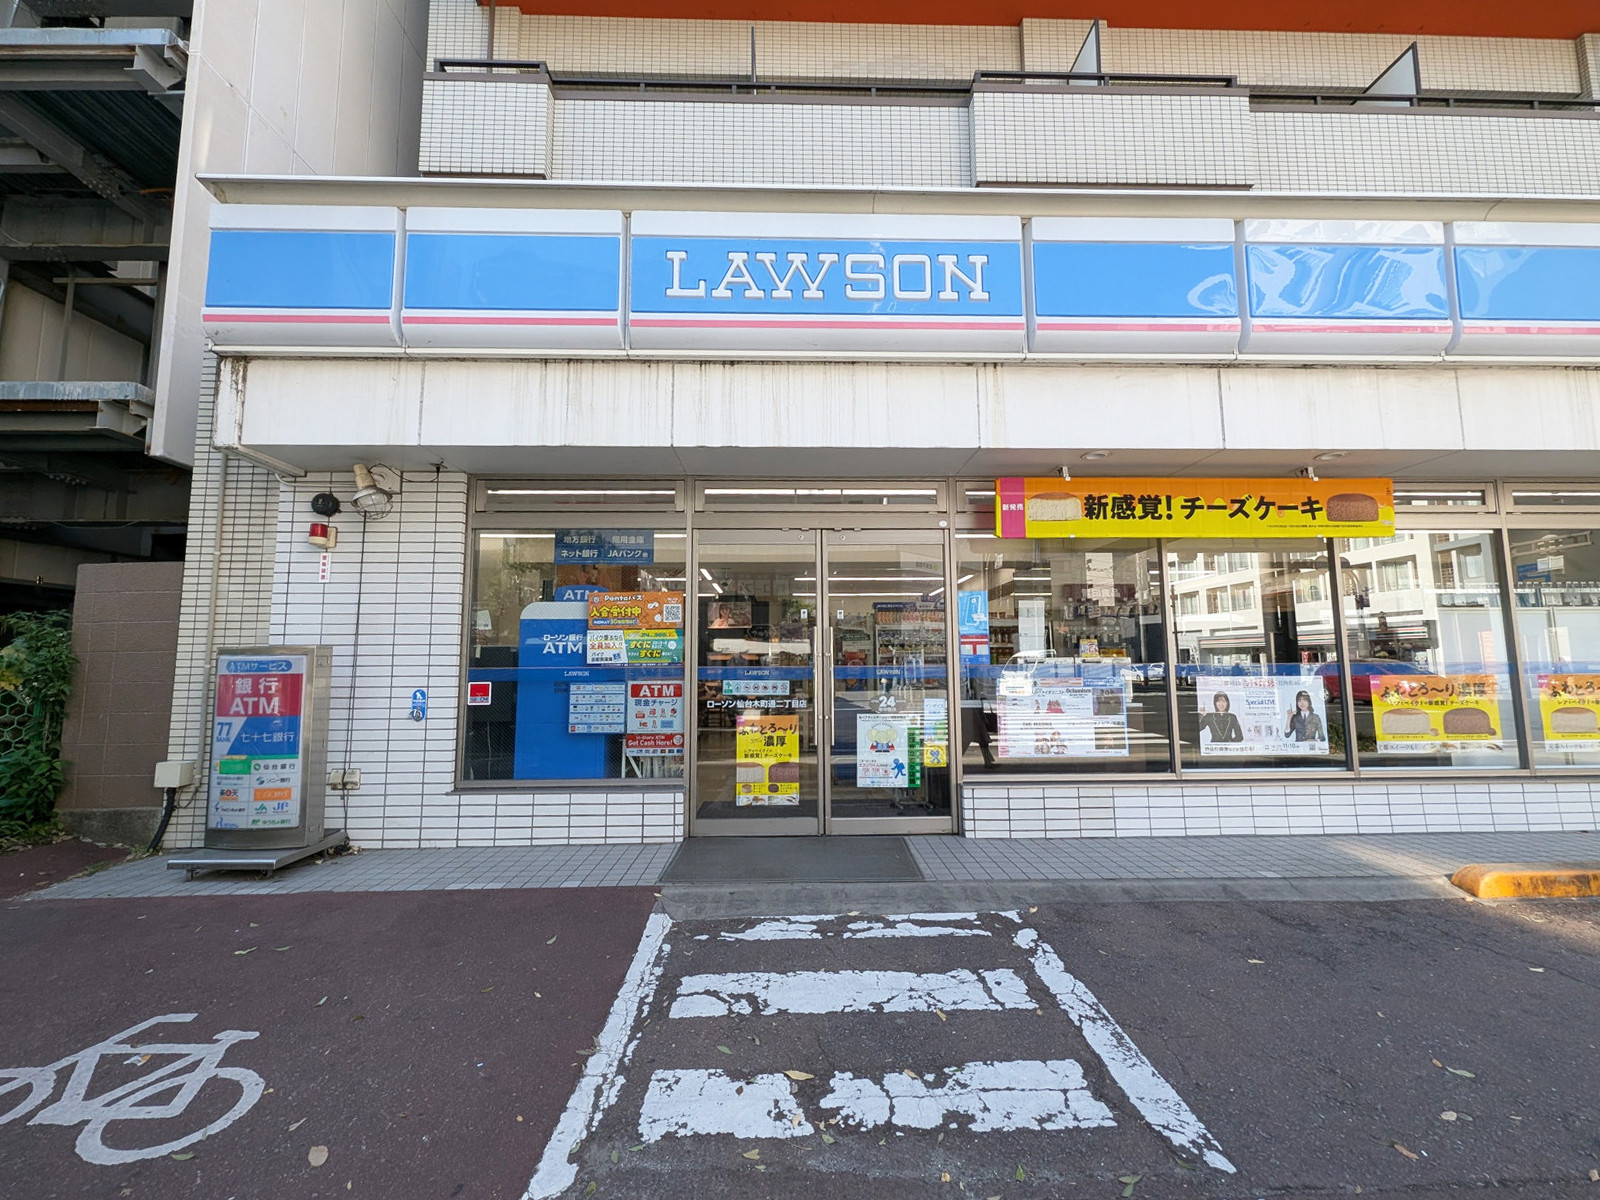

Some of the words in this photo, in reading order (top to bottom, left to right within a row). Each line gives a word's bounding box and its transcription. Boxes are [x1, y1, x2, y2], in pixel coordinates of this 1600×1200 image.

[666, 250, 990, 301] LAWSON
[1002, 503, 1024, 511] 新発売
[563, 535, 596, 544] 地方銀行
[612, 535, 645, 544] 信用金庫
[561, 549, 598, 558] ネット銀行
[590, 605, 642, 617] 入会受付中
[543, 633, 583, 641] ローソン銀行
[542, 642, 583, 654] ATM
[630, 640, 652, 649] すぐに
[639, 649, 662, 658] すぐに
[228, 661, 288, 672] ATMサービス
[235, 677, 279, 694] 銀行
[639, 684, 675, 697] ATM
[229, 696, 280, 715] ATM
[634, 698, 678, 707] 現金チャージ
[878, 695, 897, 707] 24
[217, 722, 233, 736] 77
[240, 731, 295, 743] 七十七銀行
[763, 735, 787, 747] 濃厚
